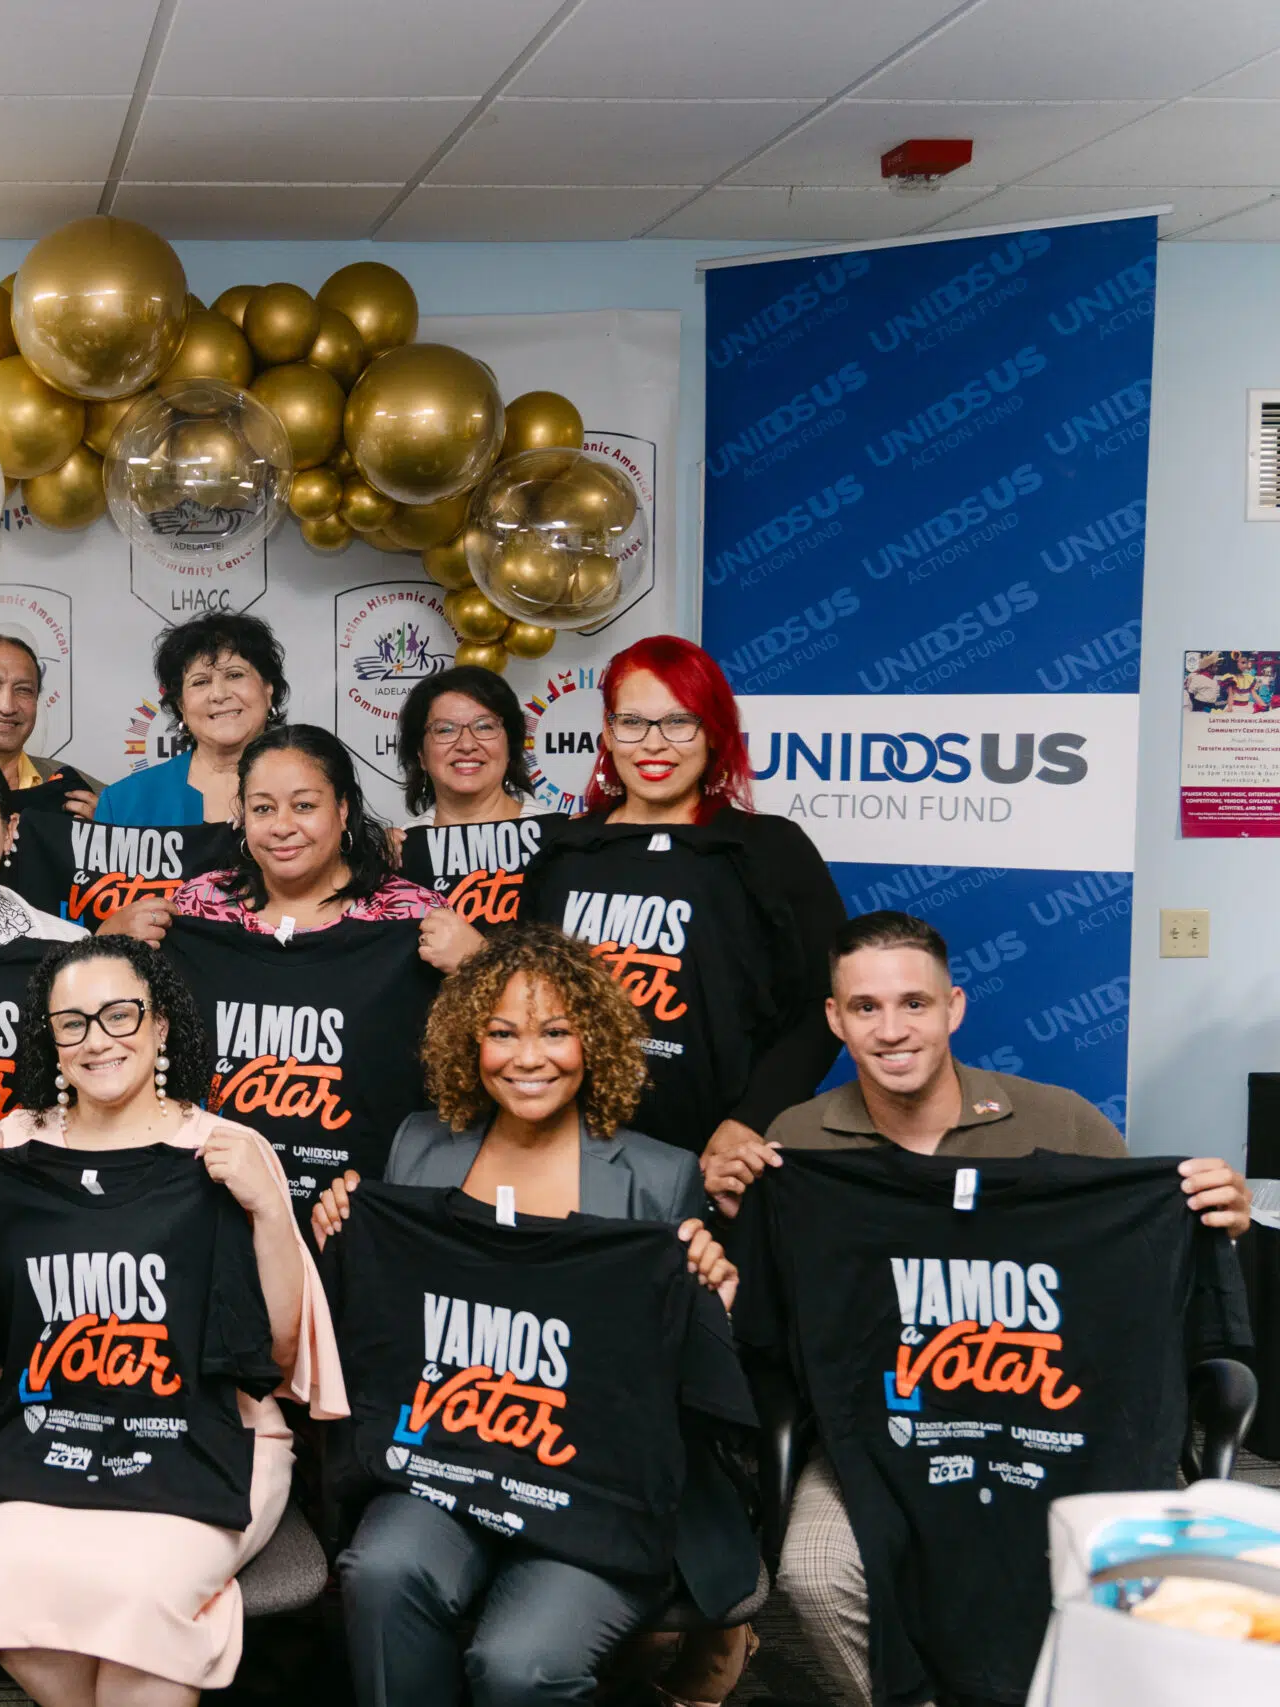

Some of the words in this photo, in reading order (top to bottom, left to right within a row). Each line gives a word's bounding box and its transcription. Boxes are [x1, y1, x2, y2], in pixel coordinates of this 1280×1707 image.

[869, 231, 1051, 352] UNIDOSUS
[1099, 299, 1154, 340] ACTIO
[707, 361, 867, 477] UNIDOSUS
[865, 345, 1047, 467] UNIDOSUS
[1094, 420, 1150, 460] ACTIO
[612, 449, 652, 502] American
[705, 474, 865, 585] UNIDOSUS
[861, 464, 1042, 579] UNIDOSUS
[1090, 541, 1145, 579] ACTIO
[172, 589, 230, 611] LHACC
[28, 600, 70, 655] American
[340, 610, 368, 649] Latino
[367, 591, 425, 612] Hispanic
[718, 587, 860, 683] NIDOSUS
[857, 581, 1039, 692] UNIDOSUS
[1086, 660, 1139, 694] ACTIO
[349, 688, 398, 721] Commun
[787, 794, 907, 820] ACTION
[919, 795, 1012, 823] FUND
[72, 821, 183, 879] VAMOS
[427, 820, 540, 876] VAMOS
[74, 870, 90, 885] a
[434, 877, 450, 891] a
[905, 884, 958, 917] CTION
[1078, 897, 1132, 934] ACTIO
[563, 890, 692, 955] VAMOS
[216, 1001, 344, 1064] VAMOS
[1074, 1015, 1128, 1051] ACTIO
[215, 1058, 234, 1073] a
[290, 1188, 311, 1198] ctory
[26, 1252, 166, 1322] VAMOS
[890, 1258, 1060, 1331] VAMOS
[40, 1323, 52, 1342] a
[424, 1292, 570, 1388] VAMOS
[900, 1326, 924, 1344] a
[422, 1362, 443, 1383] a
[102, 1456, 133, 1467] Latino
[112, 1464, 146, 1477] Victory
[988, 1461, 1022, 1475] Latino
[1000, 1472, 1039, 1489] Victory
